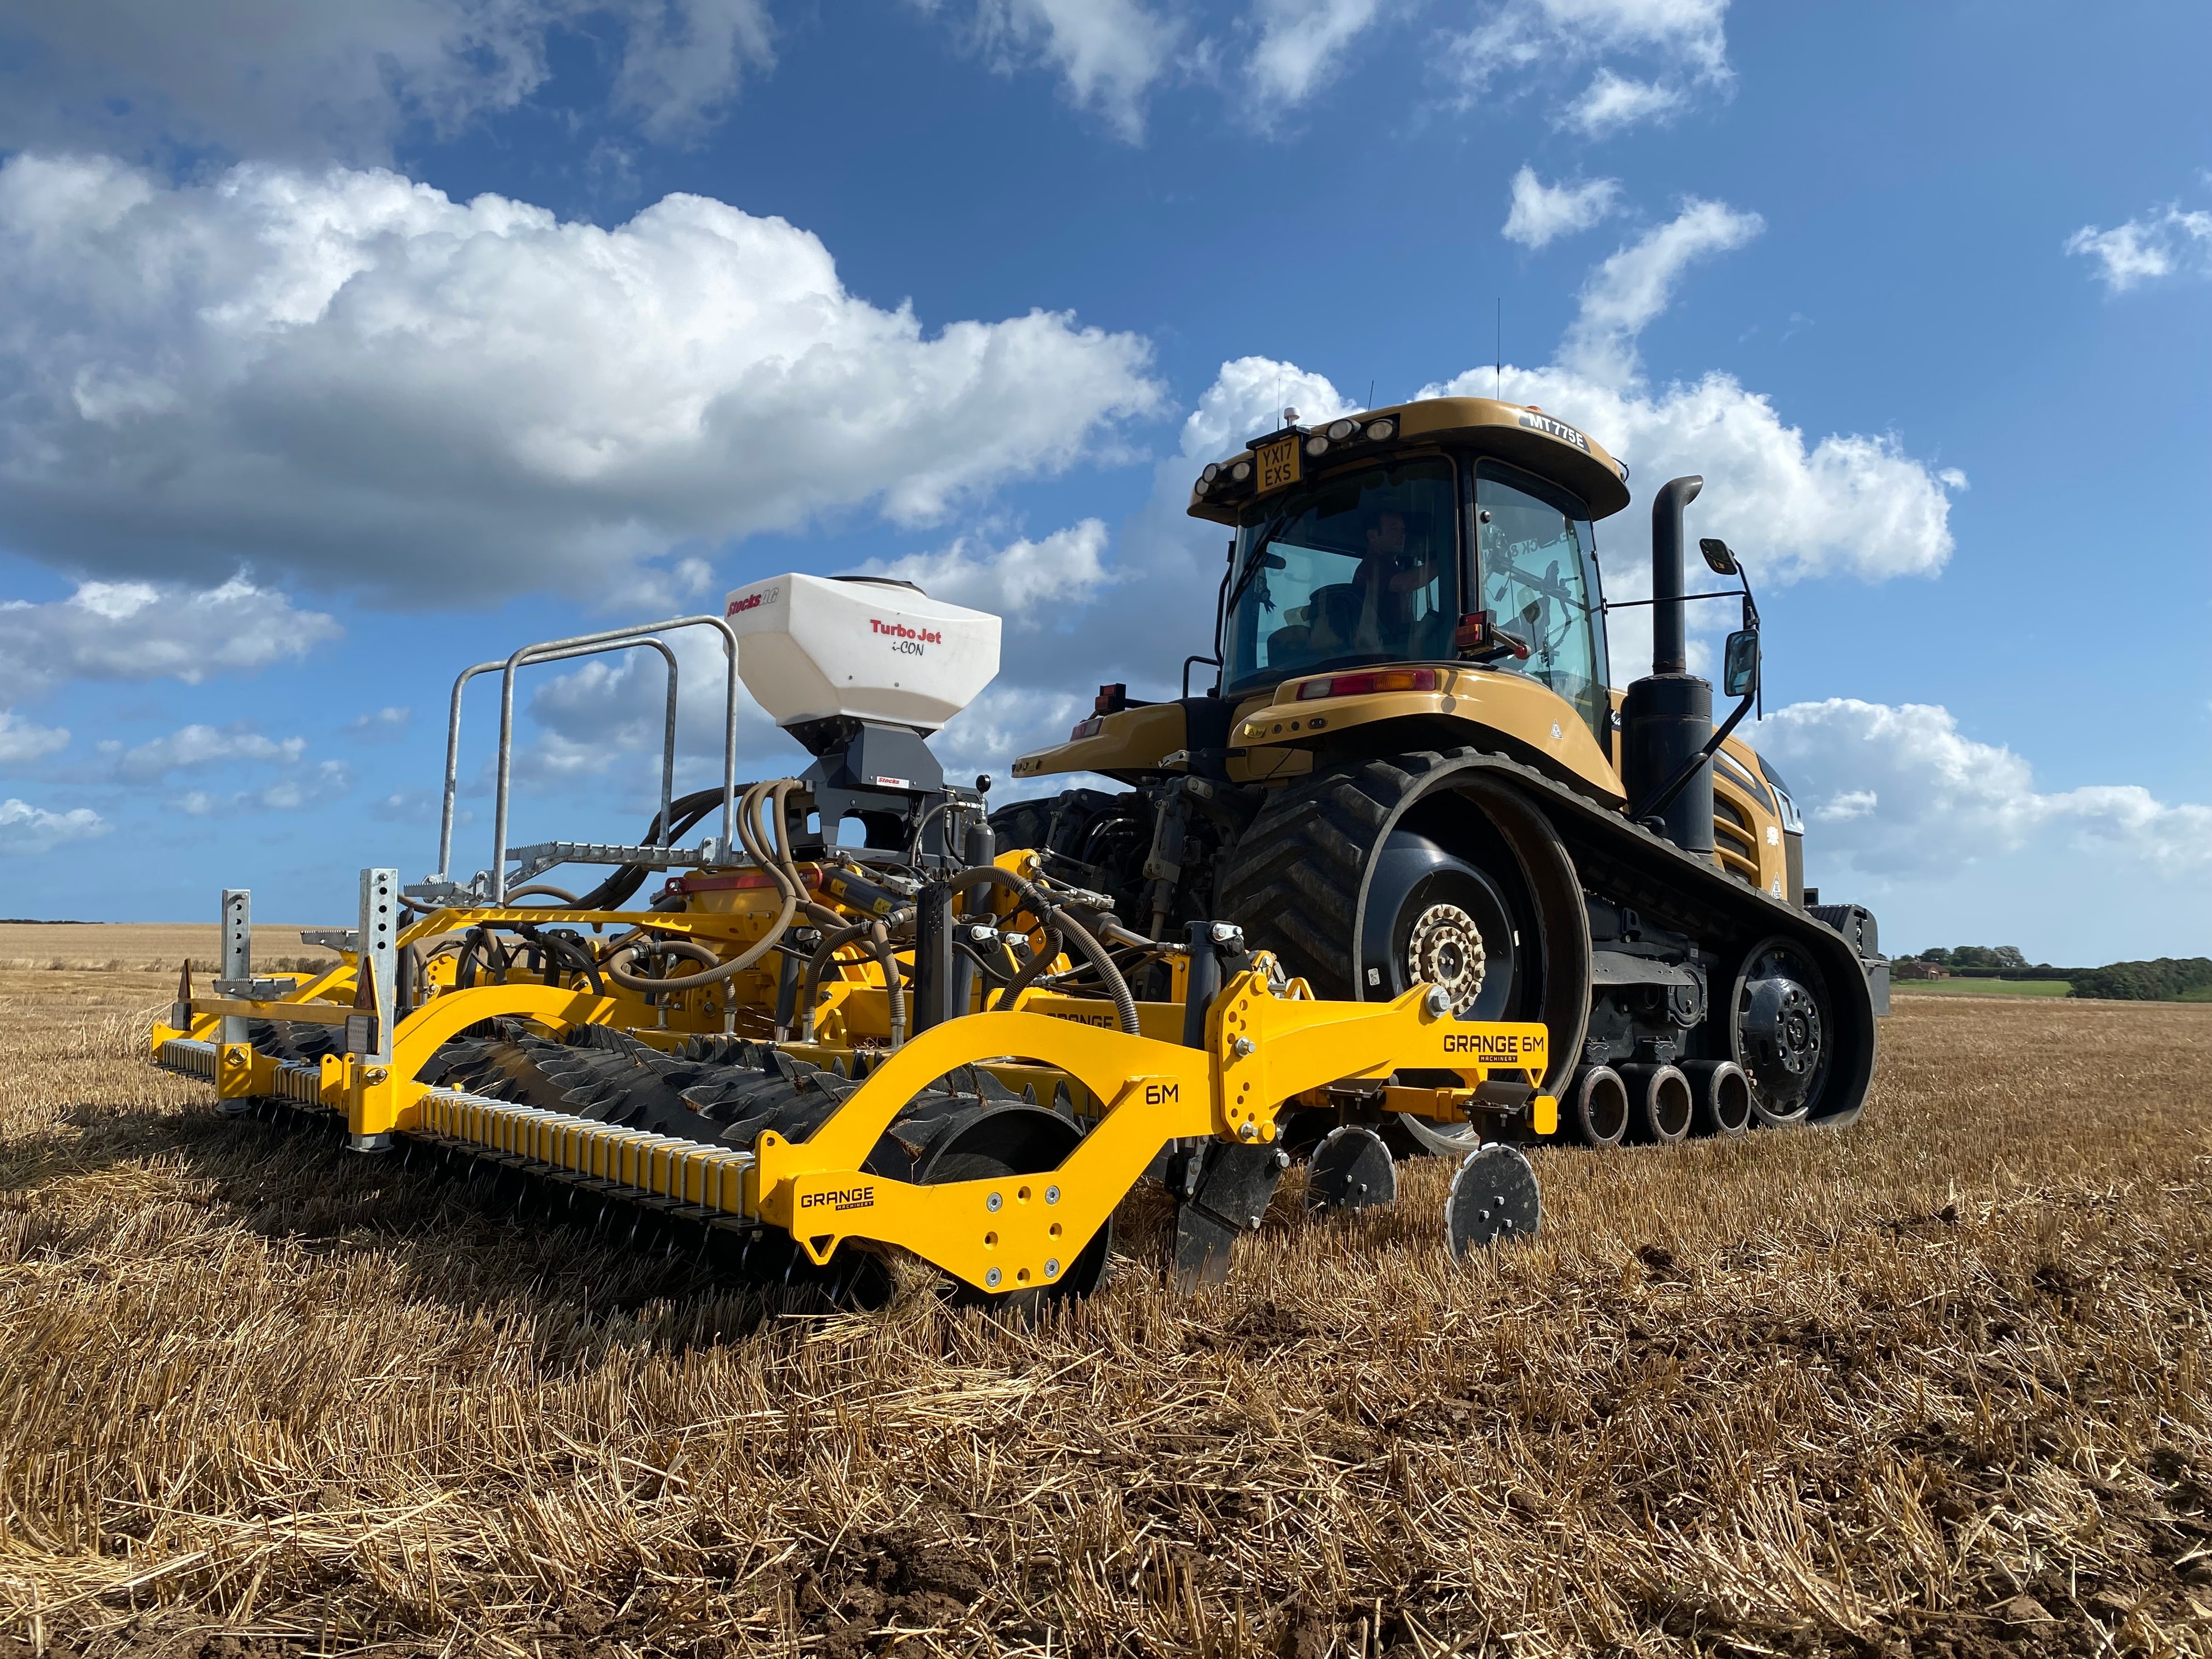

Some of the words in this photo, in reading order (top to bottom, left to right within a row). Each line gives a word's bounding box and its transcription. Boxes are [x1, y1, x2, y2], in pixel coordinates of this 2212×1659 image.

[1263, 442, 1292, 467] YX17
[1265, 463, 1291, 487] EXS
[870, 619, 916, 639] Turbo
[917, 628, 941, 645] Jet
[892, 641, 924, 656] i-CON
[1046, 1013, 1114, 1029] NGE
[1444, 1035, 1518, 1053] GRANGE
[1522, 1036, 1544, 1052] 6M
[1146, 1084, 1179, 1105] 6M
[801, 1186, 874, 1208] GRANGE
